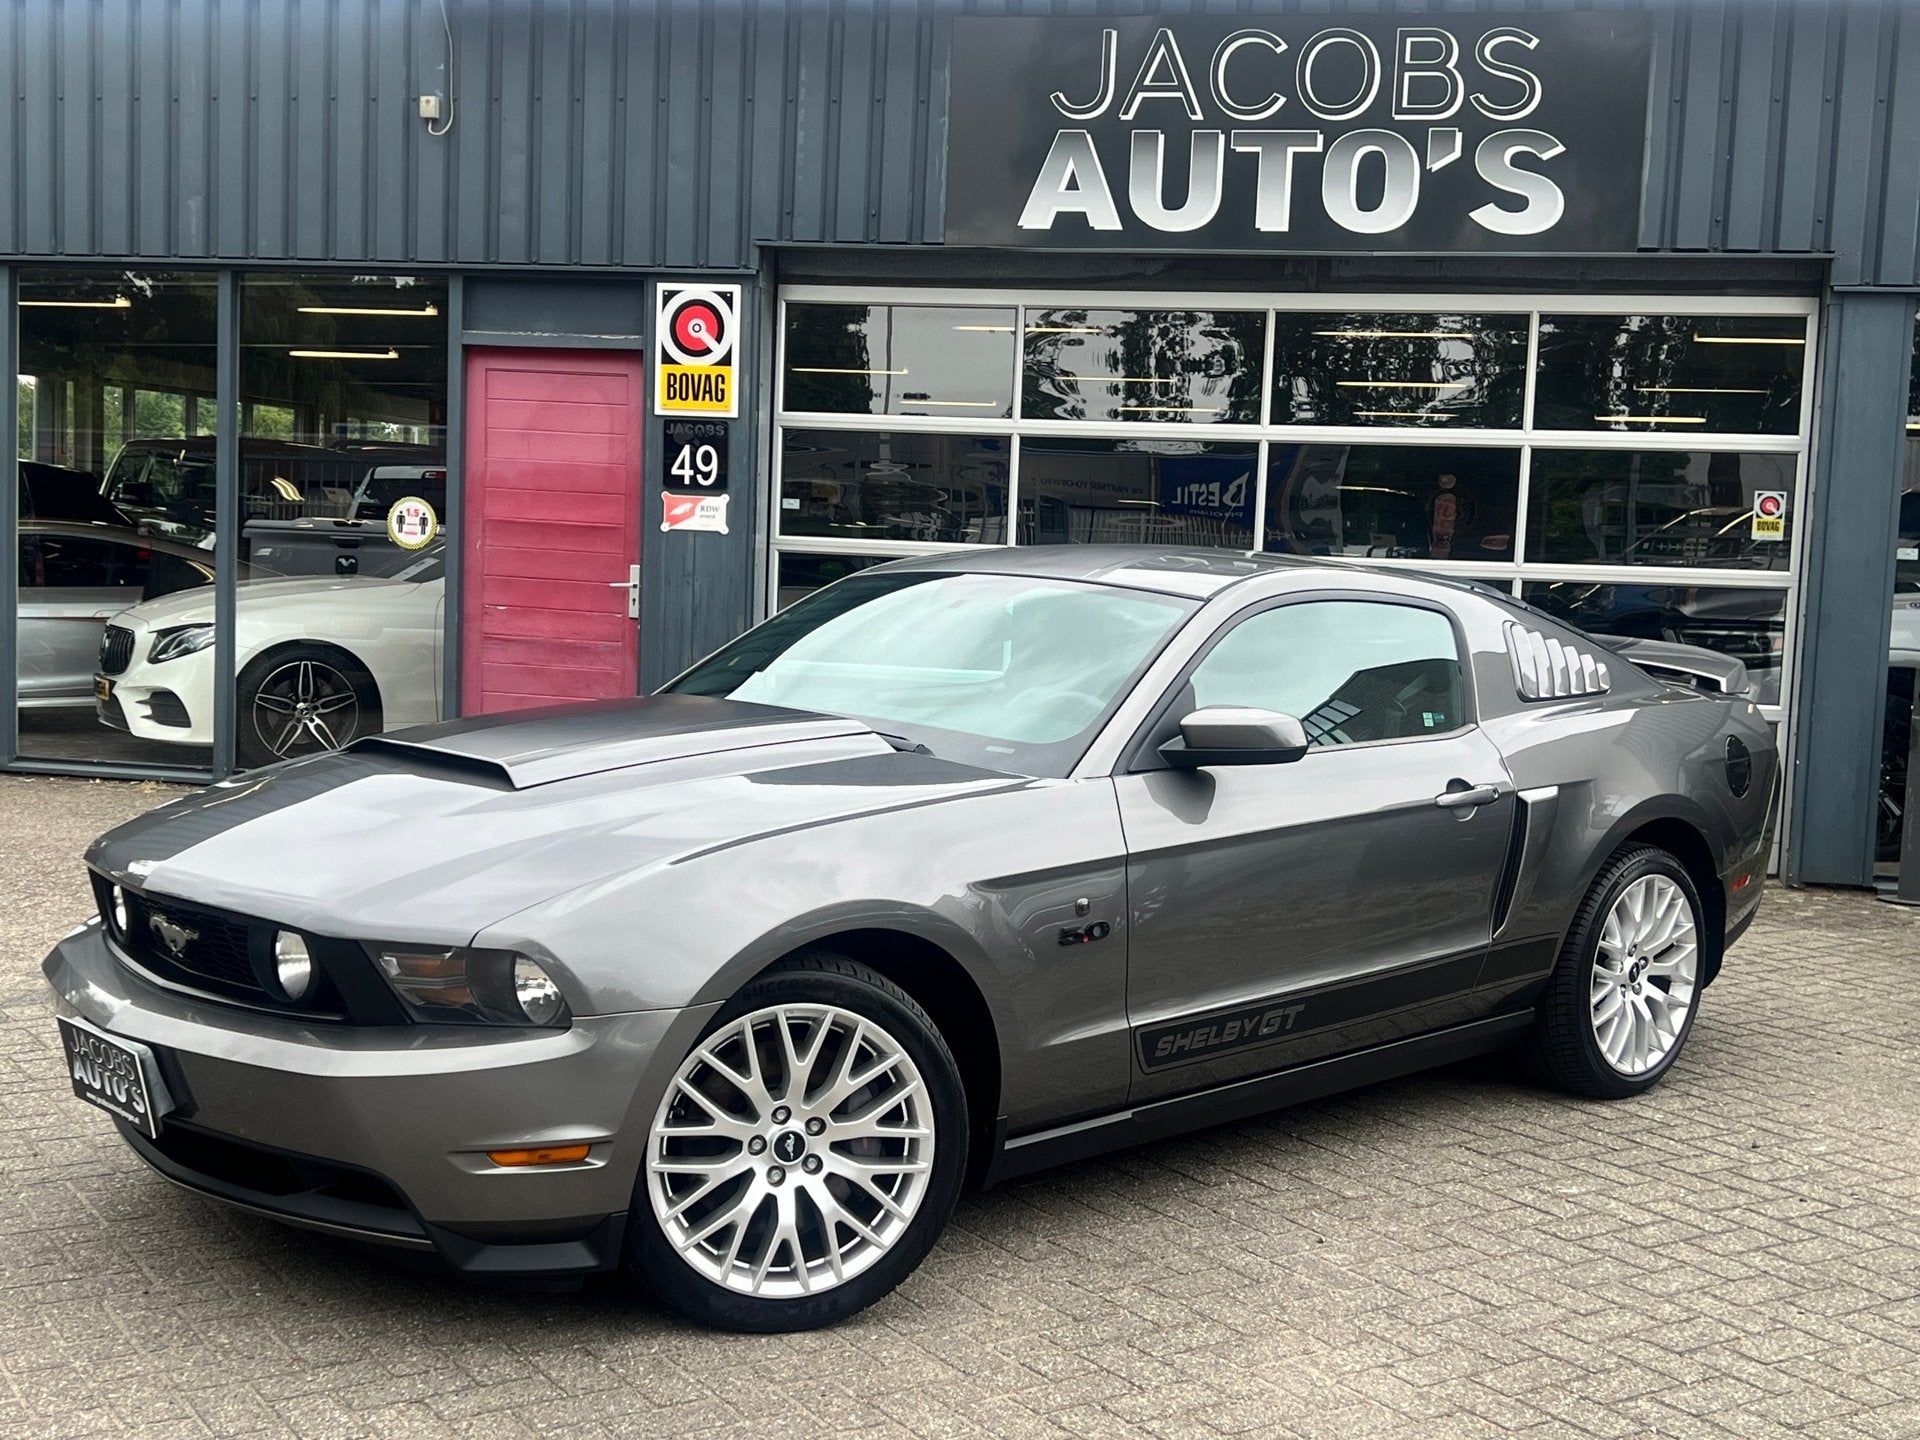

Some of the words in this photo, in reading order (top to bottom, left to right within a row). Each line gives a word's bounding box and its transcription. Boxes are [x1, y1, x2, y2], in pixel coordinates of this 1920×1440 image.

[1050, 27, 1542, 121] JACOBS
[1017, 127, 1566, 235] AUTO'S
[666, 372, 726, 403] BOVAG
[665, 422, 726, 436] JACOBS
[670, 443, 719, 486] 49
[406, 508, 420, 518] 1.5
[700, 505, 720, 513] RDW
[1756, 520, 1780, 532] BOVAG
[1057, 919, 1111, 946] 5.0
[1154, 1015, 1260, 1058] SHELBY
[1257, 1003, 1306, 1037] GT
[69, 1027, 136, 1081] JACOBS
[72, 1052, 146, 1114] AUTO'S
